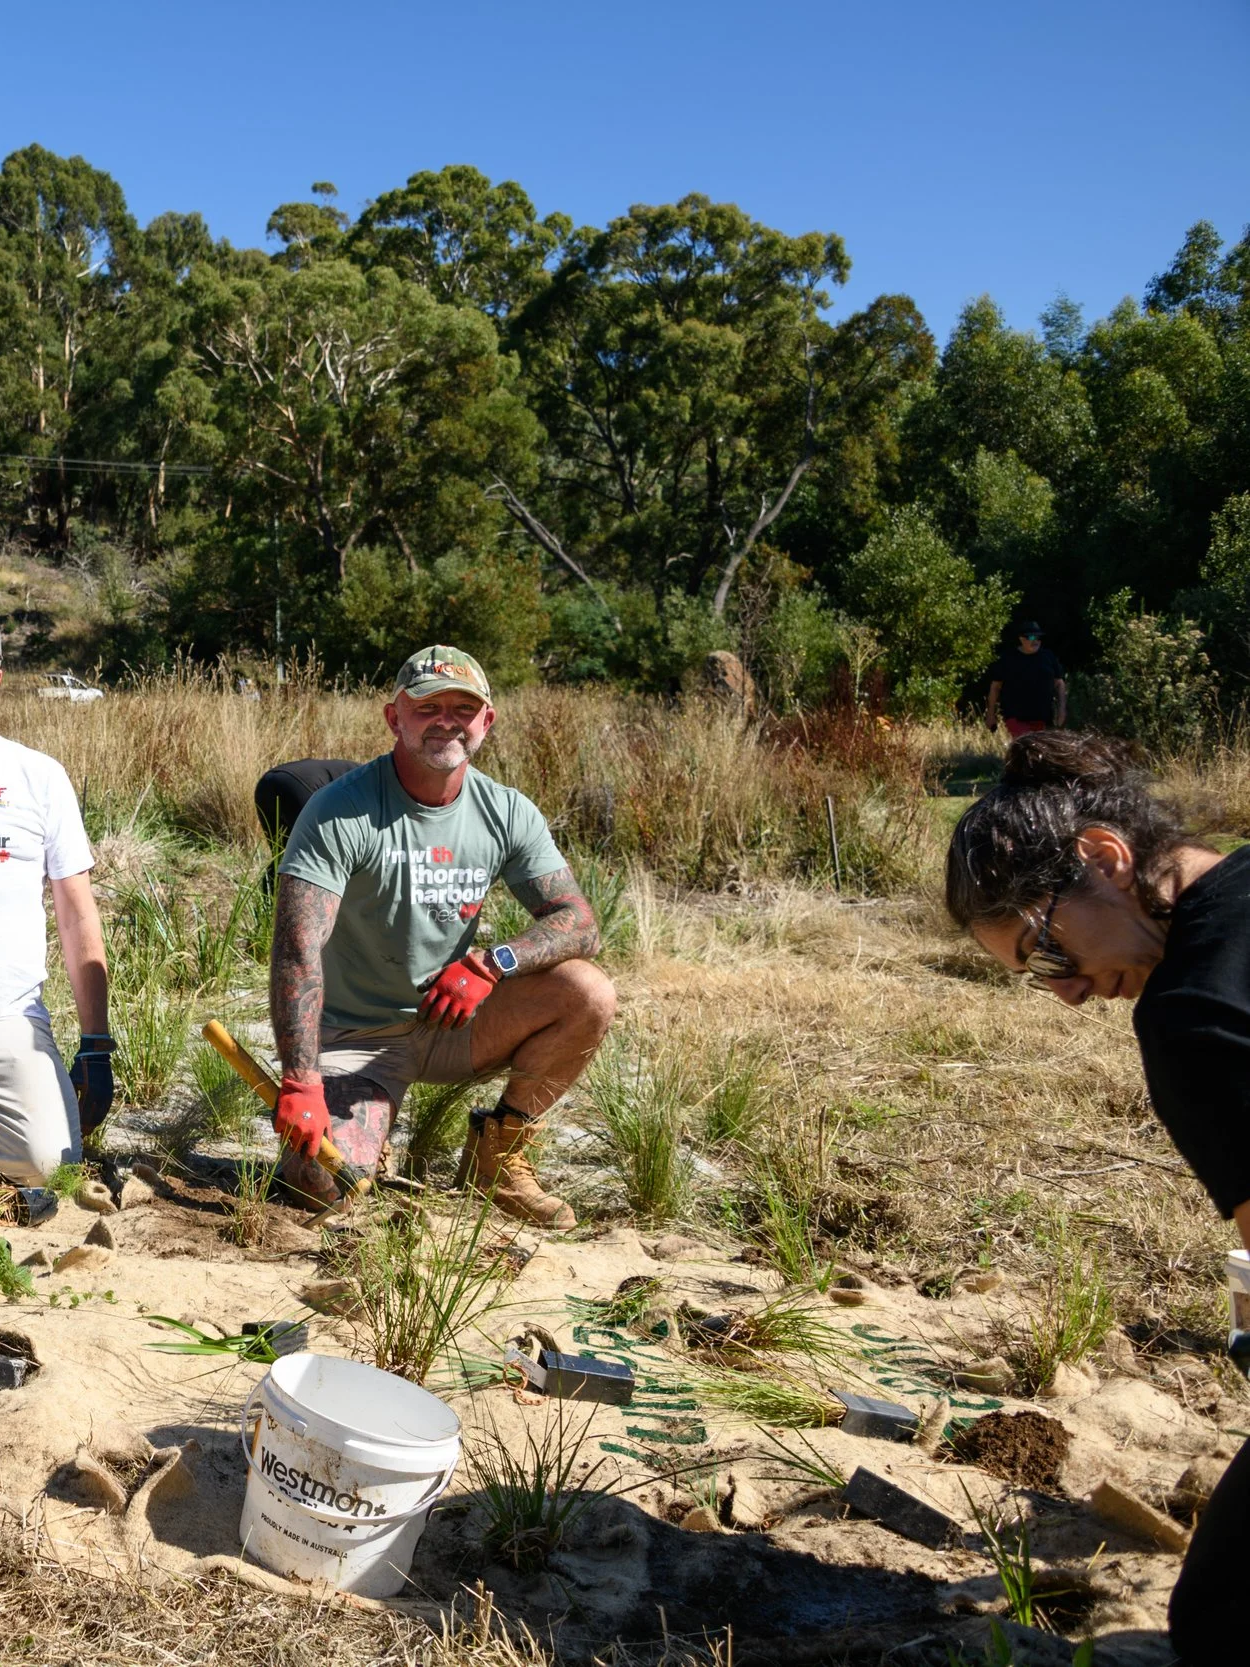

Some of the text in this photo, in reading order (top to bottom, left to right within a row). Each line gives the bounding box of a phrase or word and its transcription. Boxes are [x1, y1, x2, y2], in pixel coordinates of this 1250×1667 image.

[409, 845, 454, 864] with
[410, 864, 488, 884] thorne
[410, 884, 489, 905] harbou
[260, 1512, 348, 1560] PROUDLY MADE IN AUSTRALIA
